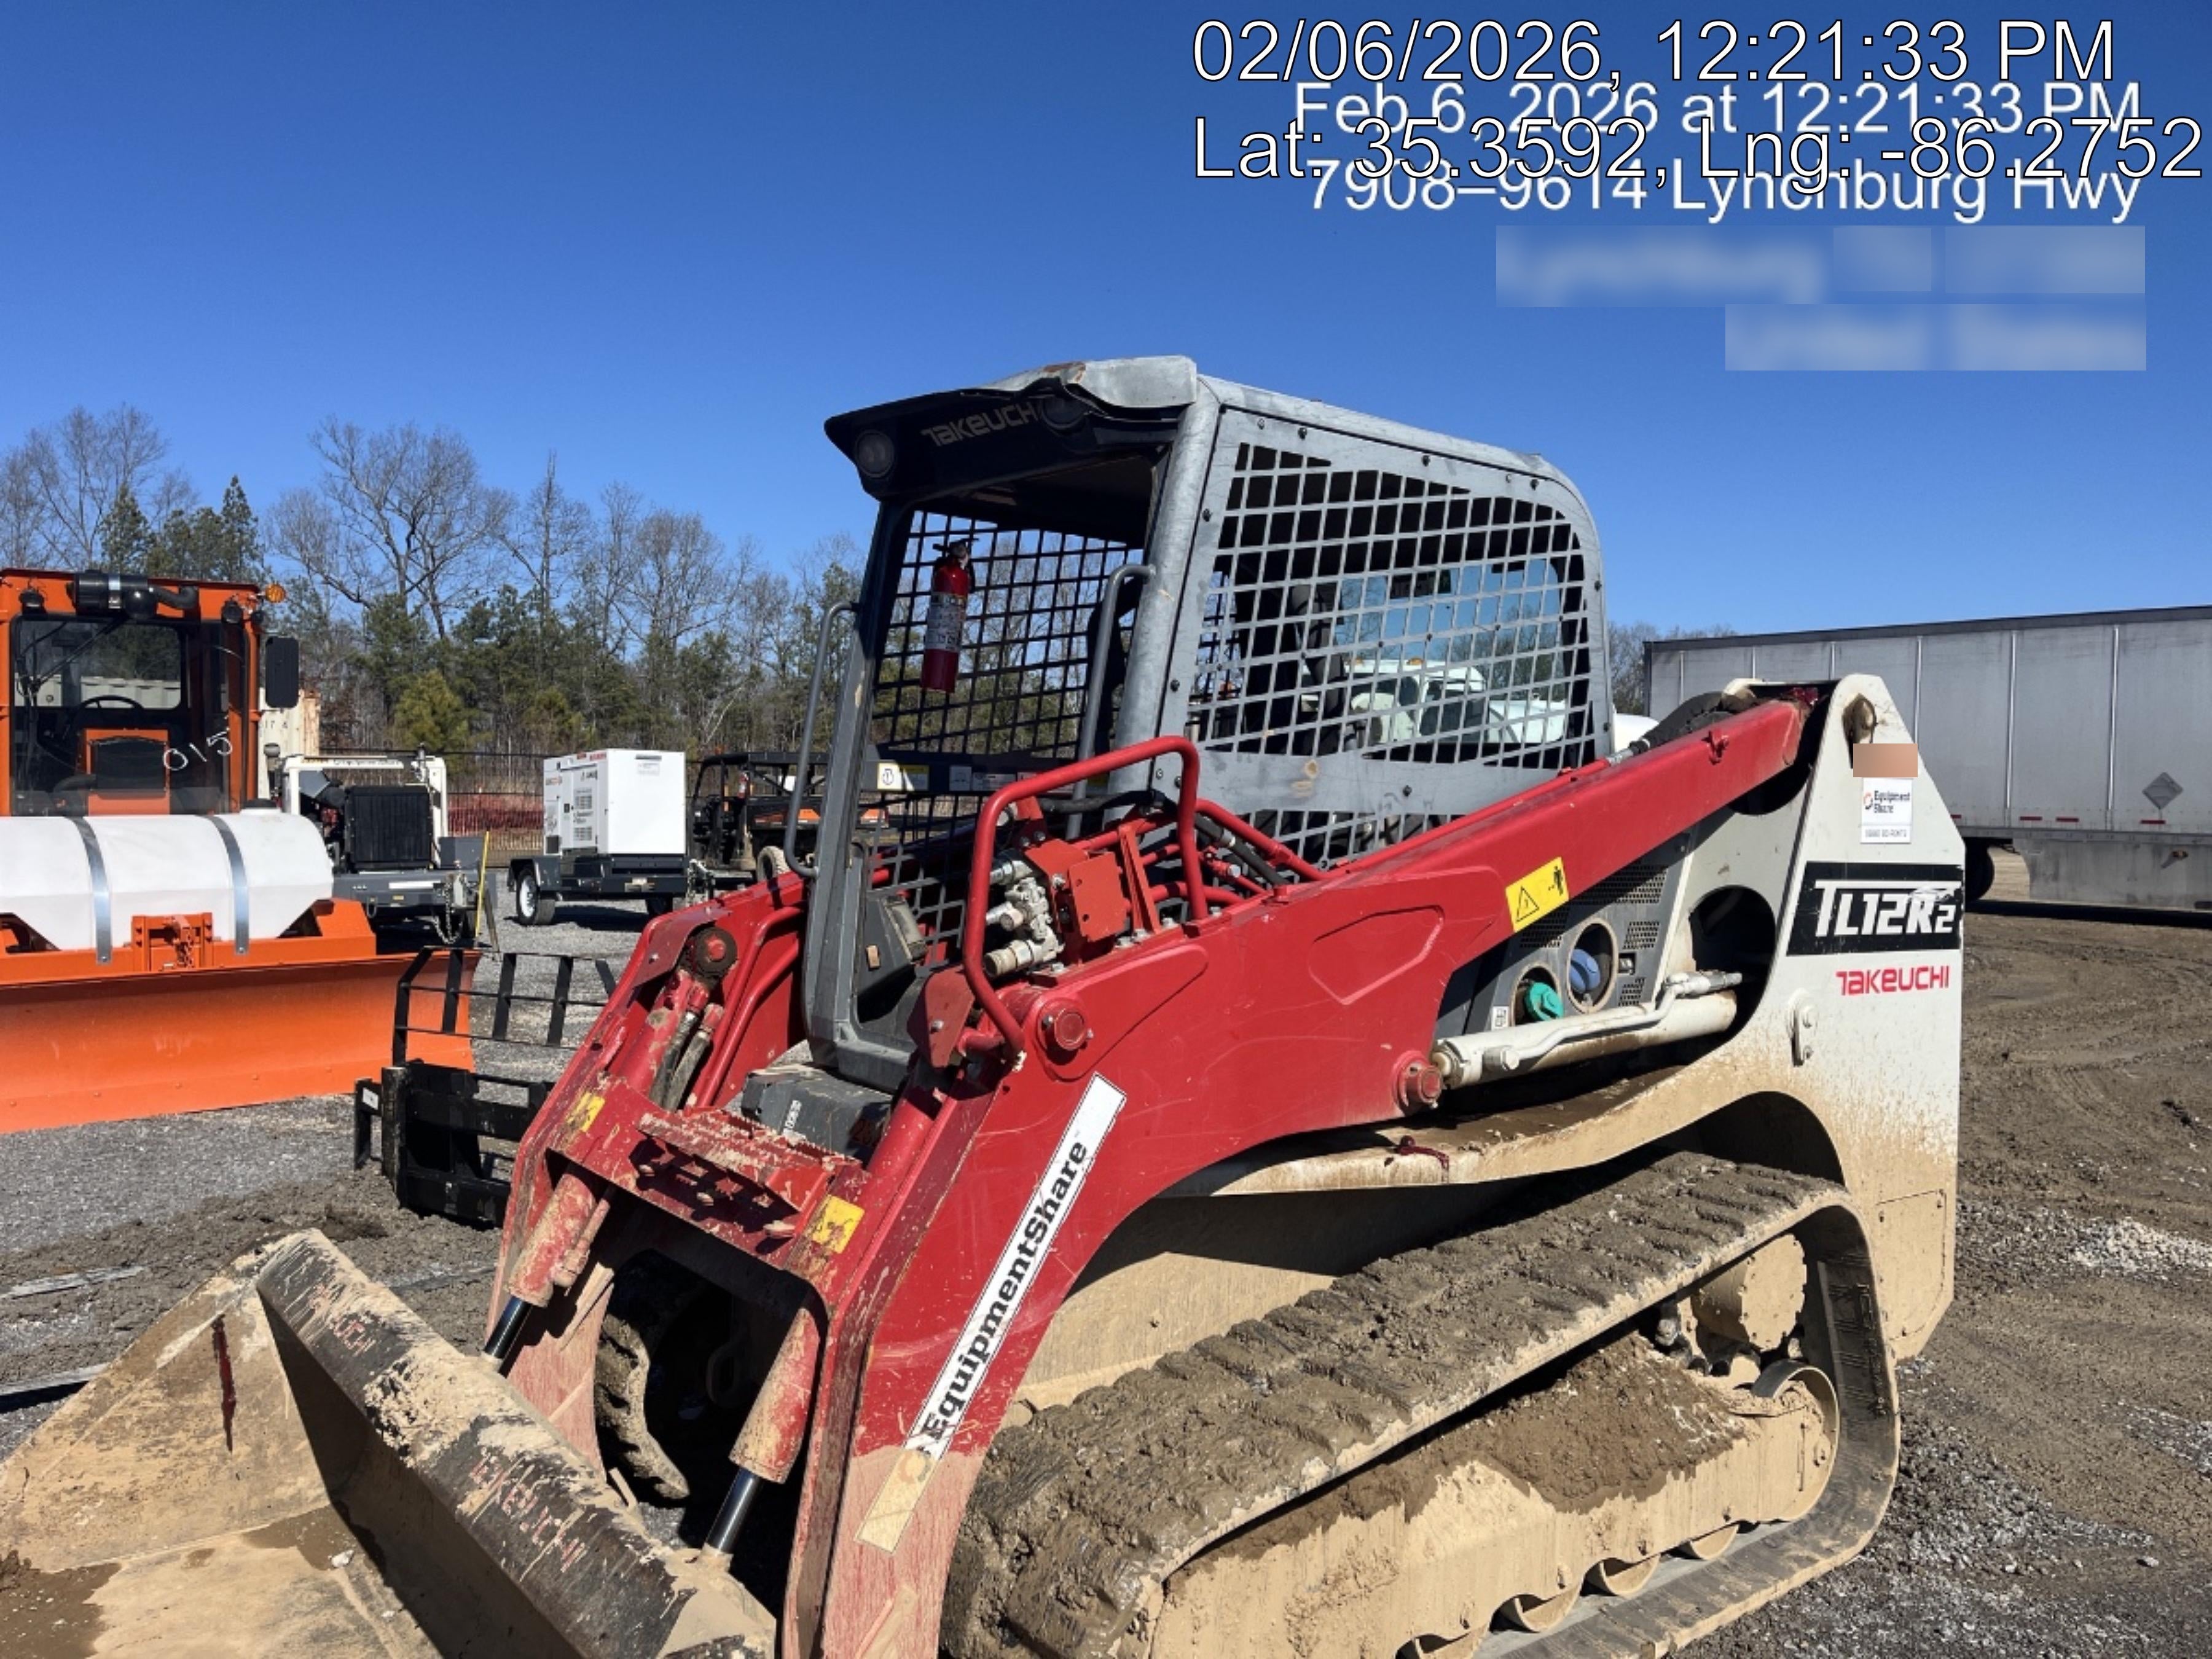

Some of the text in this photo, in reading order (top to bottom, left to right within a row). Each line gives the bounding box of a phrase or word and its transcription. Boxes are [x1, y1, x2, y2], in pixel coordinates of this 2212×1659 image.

[920, 402, 1040, 447] TAKEUCH
[1835, 965, 1950, 995] TAKEUCHI
[922, 1141, 1088, 1440] EquipmentShare
